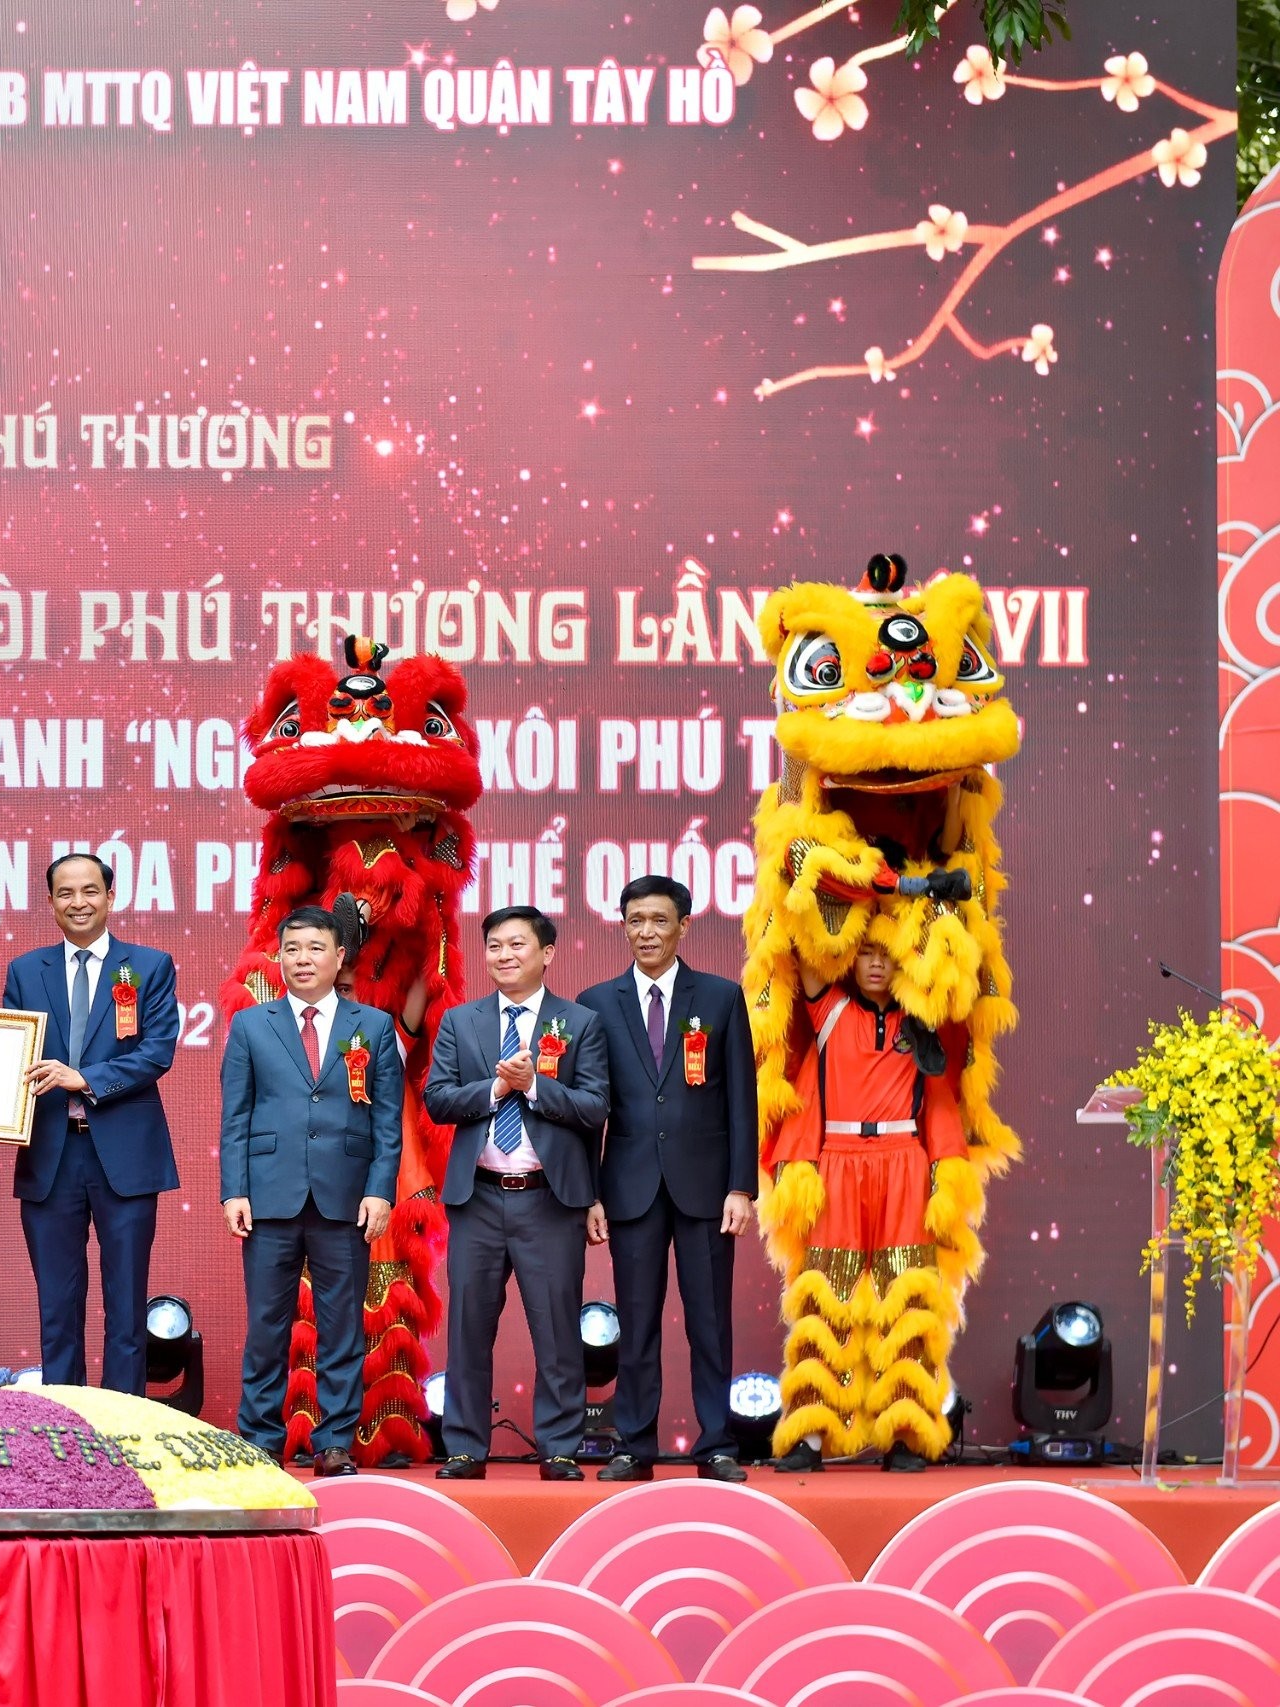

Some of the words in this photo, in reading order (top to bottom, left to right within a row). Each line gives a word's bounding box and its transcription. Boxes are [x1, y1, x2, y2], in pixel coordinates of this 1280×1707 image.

[43, 70, 173, 132] MTTQ
[186, 60, 290, 135] VIỆT
[303, 69, 408, 125] NAM
[423, 59, 552, 135] QUẬN
[564, 58, 655, 124] TÂY
[668, 48, 734, 124] HỒ
[80, 404, 334, 483] THƯỢNG
[79, 573, 232, 661] PHÚ
[616, 557, 770, 663] LẦN
[985, 588, 1086, 663] VII
[475, 706, 577, 792] XÔI
[599, 707, 723, 792] PHÚ
[52, 829, 176, 912] ÓA
[462, 815, 566, 914] THỂ
[1054, 1409, 1078, 1420] THV
